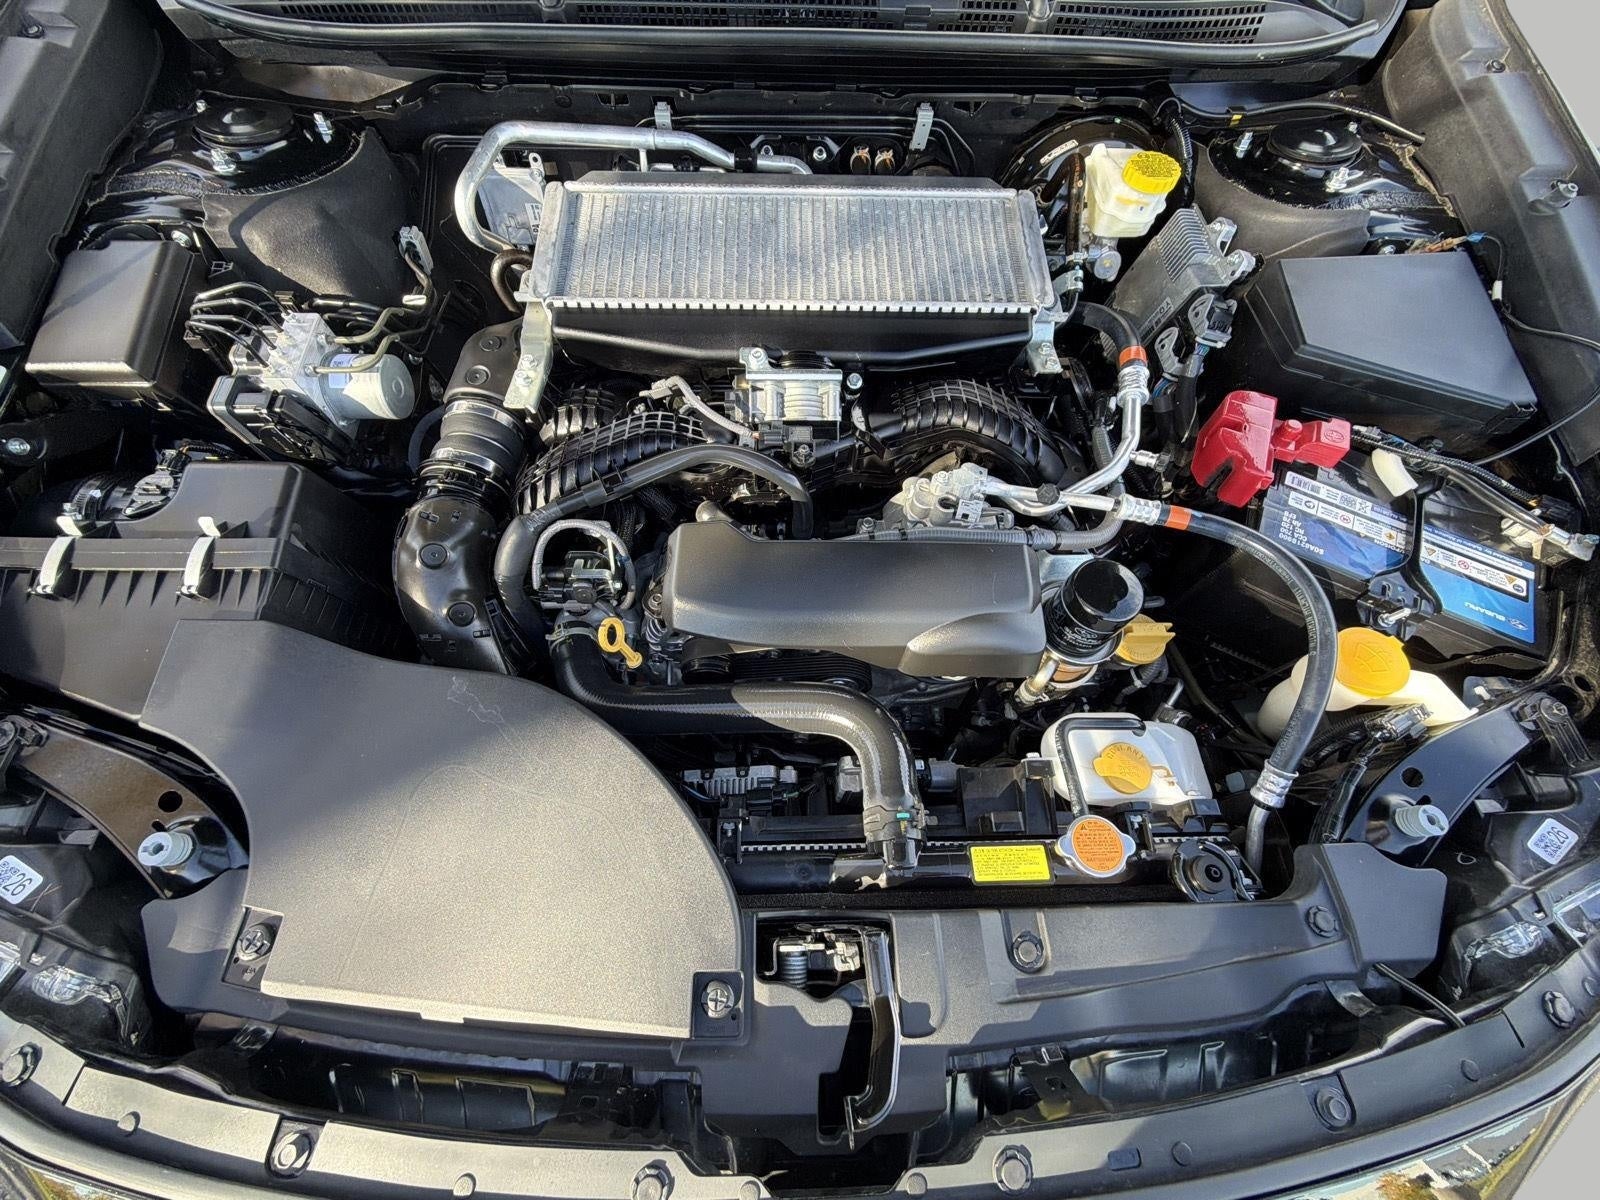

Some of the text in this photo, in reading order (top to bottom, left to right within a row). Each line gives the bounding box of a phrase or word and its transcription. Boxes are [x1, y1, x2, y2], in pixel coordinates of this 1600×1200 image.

[1280, 526, 1308, 542] CCA 750
[1281, 521, 1294, 531] 120
[1464, 601, 1506, 621] SUBARU
[2, 872, 33, 896] 26
